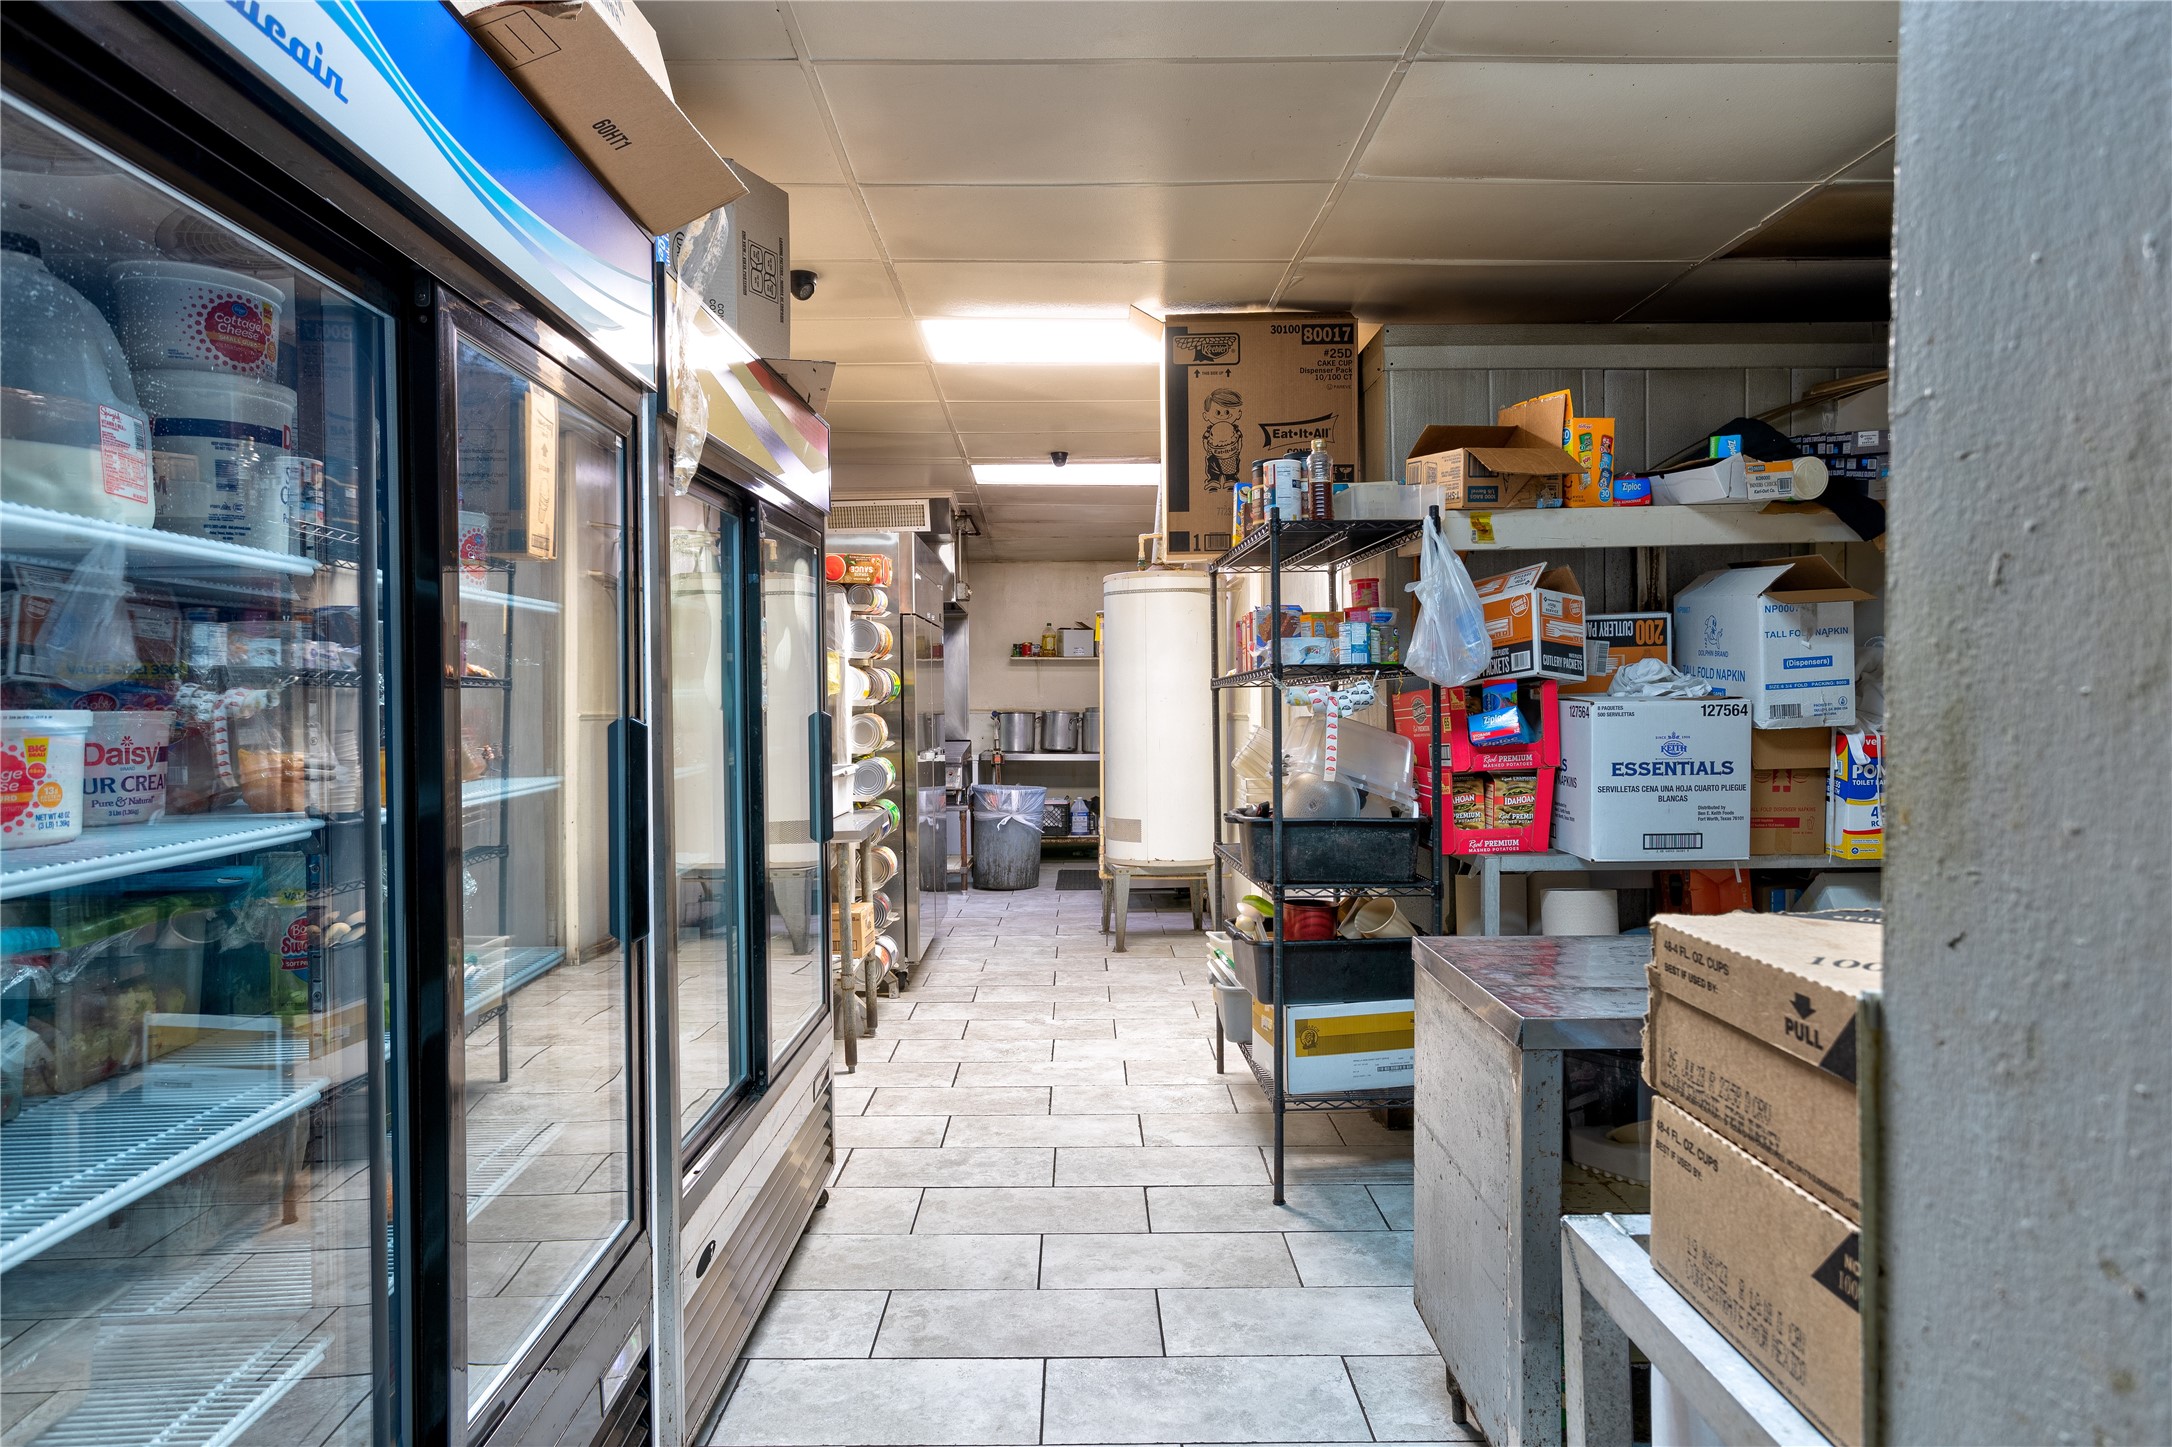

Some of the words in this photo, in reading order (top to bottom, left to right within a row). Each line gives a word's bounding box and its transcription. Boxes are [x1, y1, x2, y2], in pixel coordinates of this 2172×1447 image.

[224, 0, 349, 104] ueair
[214, 312, 263, 335] Cottage
[218, 322, 260, 341] Cheese
[1270, 325, 1300, 334] 30100
[1303, 327, 1351, 342] 80017
[1323, 348, 1353, 359] #25D
[1299, 367, 1334, 376] Dispenser
[1335, 366, 1353, 374] Pack
[1315, 373, 1341, 381] 10/100
[1622, 482, 1642, 492] Ziploc
[1445, 491, 1461, 500] T-SHI
[1602, 621, 1633, 637] CUTLERY
[1636, 619, 1664, 645] 200
[1765, 630, 1787, 639] TALL
[1815, 627, 1849, 636] NAPKIN
[1698, 649, 1714, 657] DOLPHIN
[1714, 650, 1729, 658] BRAND
[1542, 654, 1563, 667] CUTLERY
[1563, 657, 1583, 671] PACKETS
[1786, 658, 1830, 667] (Dispensers)
[68, 664, 111, 675] VALUE
[1697, 666, 1715, 680] FOLD
[1716, 668, 1746, 682] NAPKIN
[1569, 705, 1590, 719] 127564
[1701, 704, 1748, 717] 127564
[27, 744, 47, 752] BIG
[84, 737, 160, 770] Daisy
[1661, 744, 1687, 754] KEITH
[1498, 754, 1533, 762] PREMIUM
[1611, 760, 1735, 777] ESSENTIALS
[83, 777, 116, 795] UR
[121, 774, 167, 793] CREA
[1597, 785, 1640, 793] SERVILLETAS
[1641, 784, 1659, 793] CENA
[1660, 784, 1674, 793] UNA
[1675, 784, 1693, 792] HOJA
[1694, 783, 1720, 792] CUARTO
[1721, 783, 1747, 791] PLIEGUE
[91, 798, 114, 808] Pure
[115, 796, 128, 807] &
[128, 795, 155, 806] Natural
[1452, 793, 1475, 804] AHOAN
[1658, 794, 1688, 803] BLANCAS
[1720, 804, 1726, 812] by
[35, 814, 48, 822] NET
[48, 813, 57, 821] WT
[58, 812, 64, 820] 48
[64, 811, 71, 819] OZ
[1512, 812, 1533, 820] PREMI
[38, 823, 44, 831] (3
[45, 822, 55, 830] LB)
[1484, 838, 1519, 847] PREMIUM
[291, 925, 307, 936] Bo
[1706, 956, 1730, 977] CUPS
[1664, 963, 1680, 978] BEST
[1681, 969, 1687, 981] IF
[1688, 972, 1706, 989] USED
[1706, 981, 1719, 995] BY:
[1784, 1015, 1824, 1051] PULL
[1655, 1138, 1669, 1156] BEST
[1670, 1149, 1676, 1161] IF
[1676, 1154, 1692, 1174] USED
[1693, 1165, 1703, 1182] BY:
[1697, 1148, 1720, 1174] CUPS
